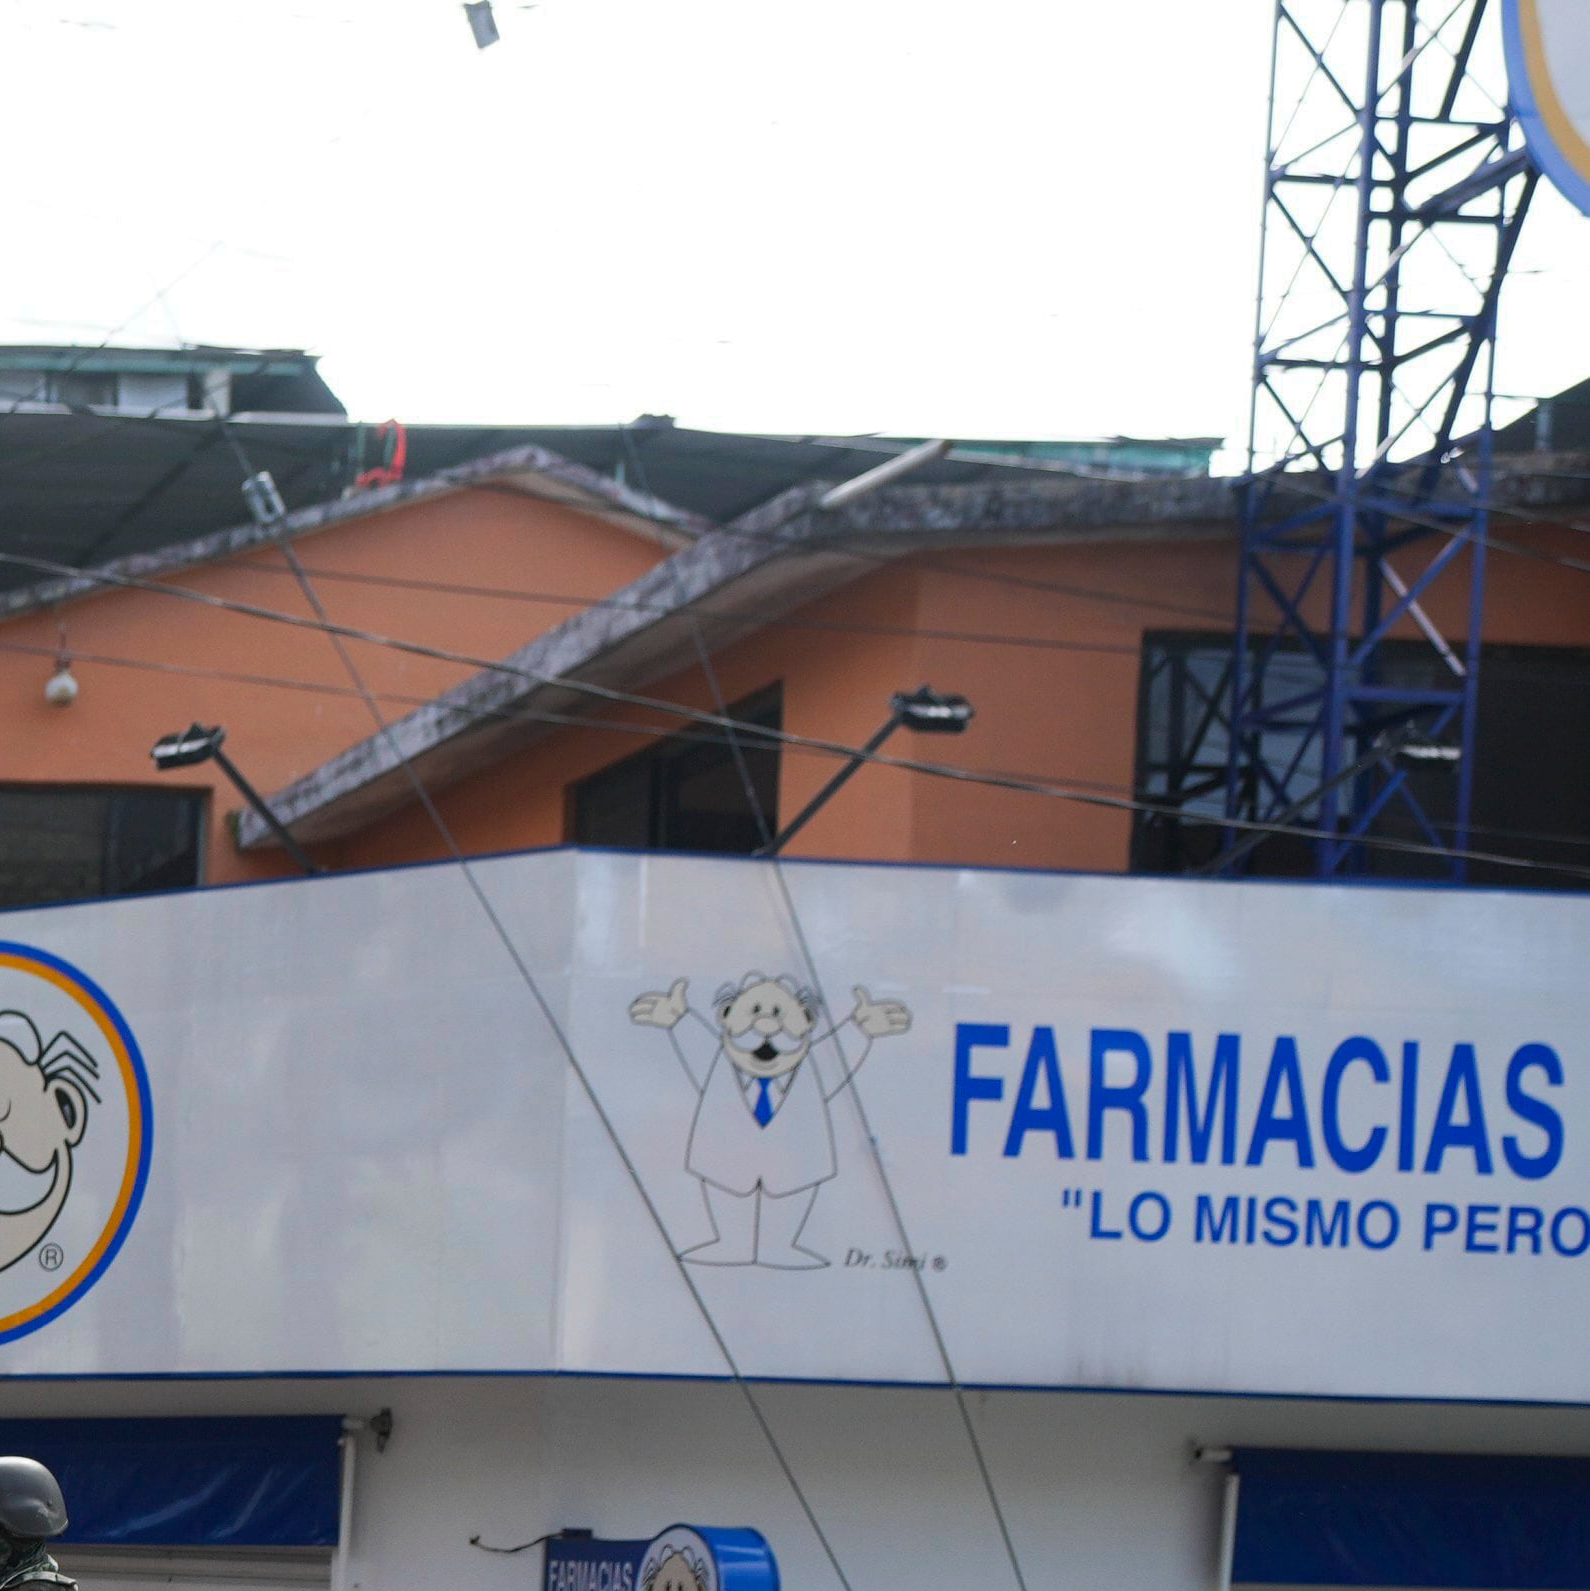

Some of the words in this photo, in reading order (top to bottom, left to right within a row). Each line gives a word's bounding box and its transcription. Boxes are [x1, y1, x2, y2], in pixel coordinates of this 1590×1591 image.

[950, 1021, 1567, 1182] FARMACIAS
[1061, 1187, 1173, 1244] "LO
[1194, 1192, 1402, 1252] MISMO
[1423, 1201, 1590, 1259] PERO
